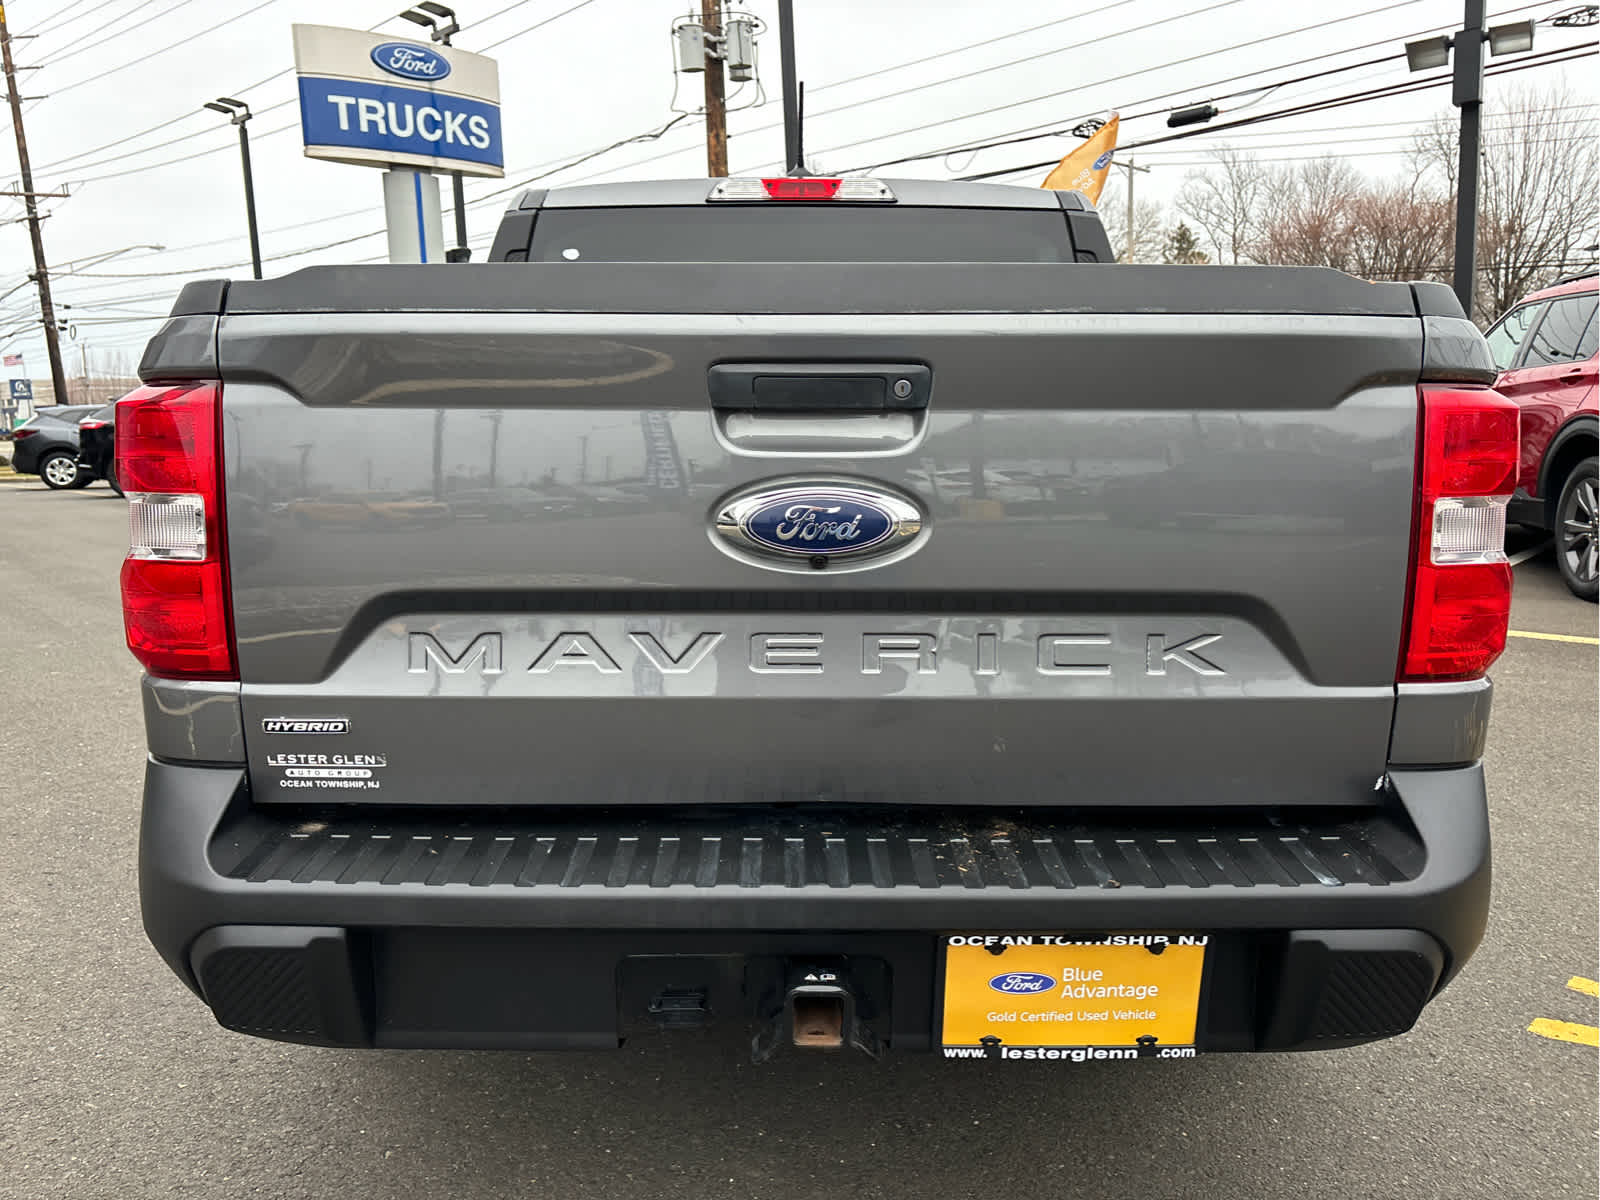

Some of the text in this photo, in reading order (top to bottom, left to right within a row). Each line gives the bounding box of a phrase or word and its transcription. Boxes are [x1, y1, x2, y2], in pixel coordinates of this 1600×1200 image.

[389, 47, 437, 75] Ford
[327, 94, 490, 149] TRUCKS
[776, 504, 862, 541] Ford
[407, 631, 1228, 677] MAVERICK
[266, 722, 345, 731] HYBRID
[267, 754, 328, 764] LESTER
[280, 780, 380, 789] OCEAN TOWNSHIP, NJ
[948, 935, 1208, 946] OCEAN TOSHIP, NJ
[1001, 967, 1103, 991] Ford Blue
[1060, 984, 1158, 1000] Advantage
[987, 1009, 1156, 1022] Gold Certified Used Vehicle
[943, 1047, 1196, 1062] www. lesterglenn .com
